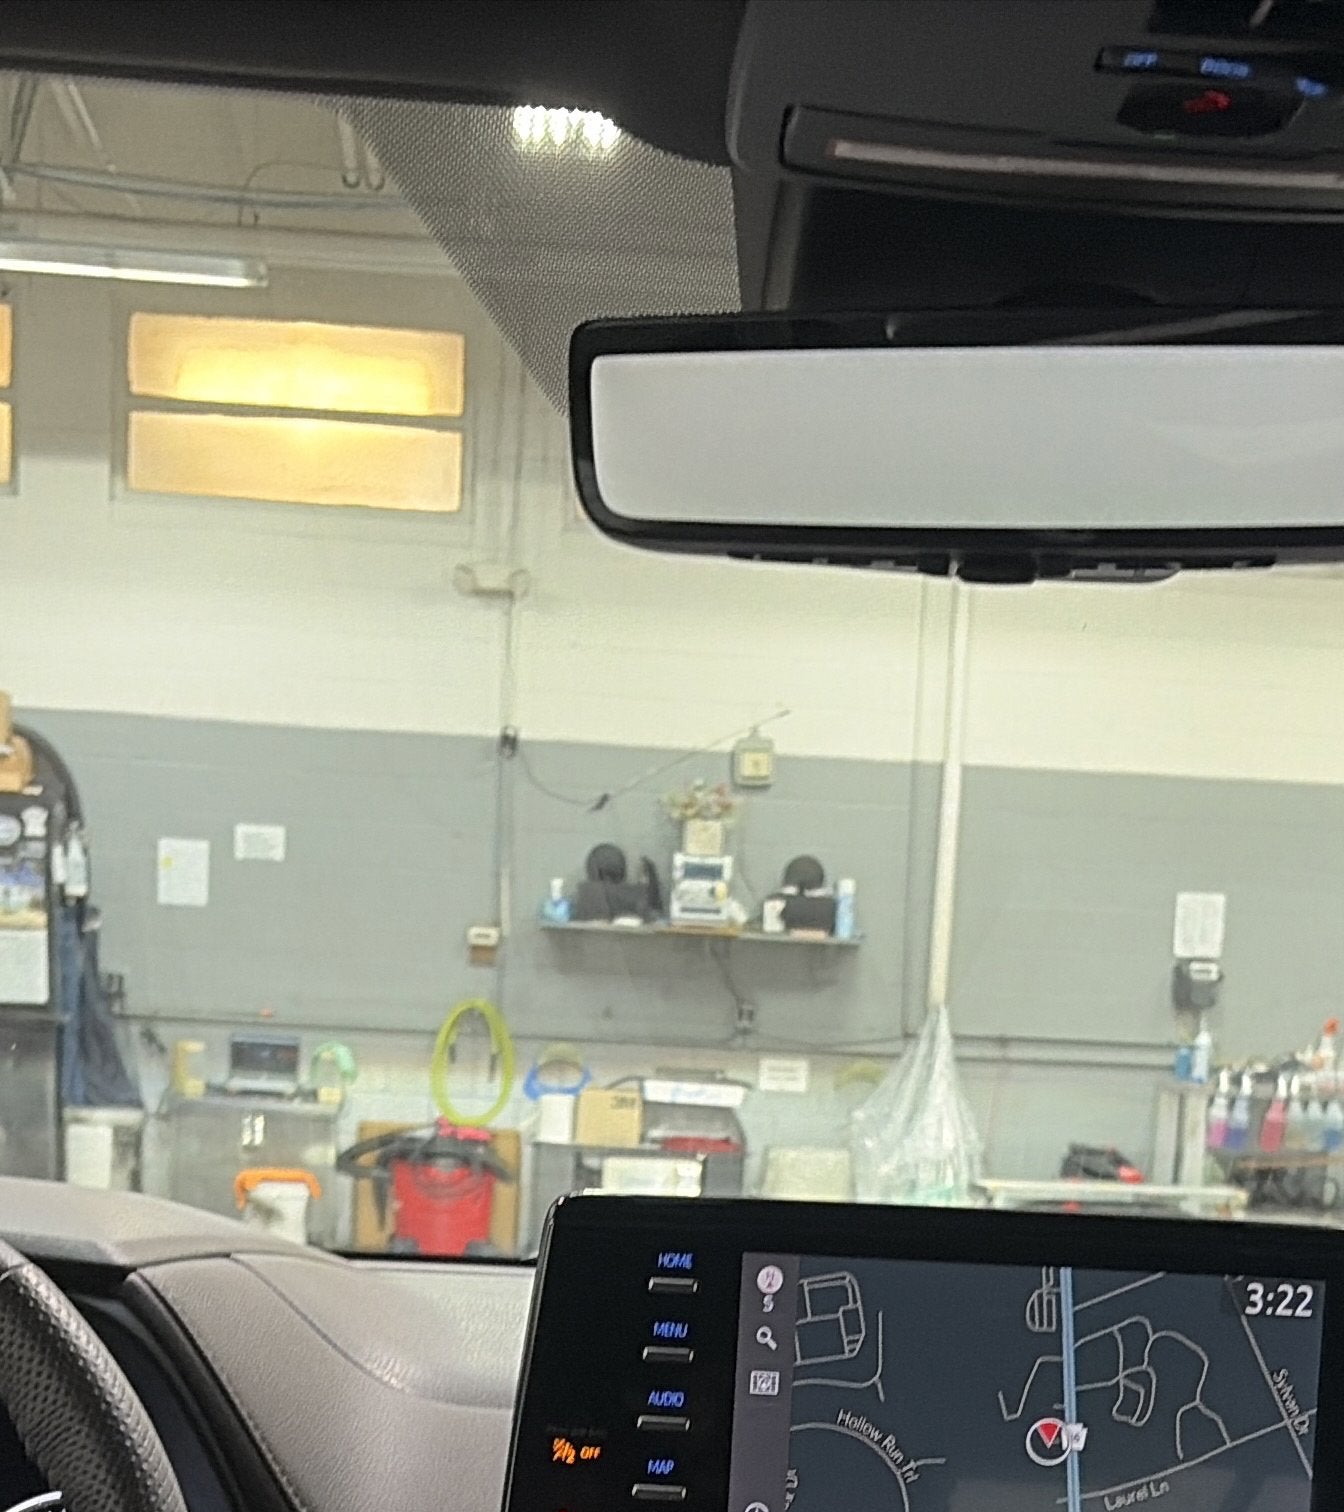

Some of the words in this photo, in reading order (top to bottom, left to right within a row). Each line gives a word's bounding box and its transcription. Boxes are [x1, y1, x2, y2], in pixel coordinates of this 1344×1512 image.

[657, 1252, 694, 1270] HOME
[1244, 1282, 1314, 1318] 3:22
[653, 1321, 689, 1339] MENU
[647, 1390, 685, 1407] AUDIO
[836, 1408, 884, 1443] Hollow
[880, 1433, 904, 1466] Run
[580, 1446, 601, 1459] OFF
[647, 1460, 675, 1475] MAP
[1103, 1484, 1149, 1512] Laurel
[1149, 1480, 1170, 1498] Ln
